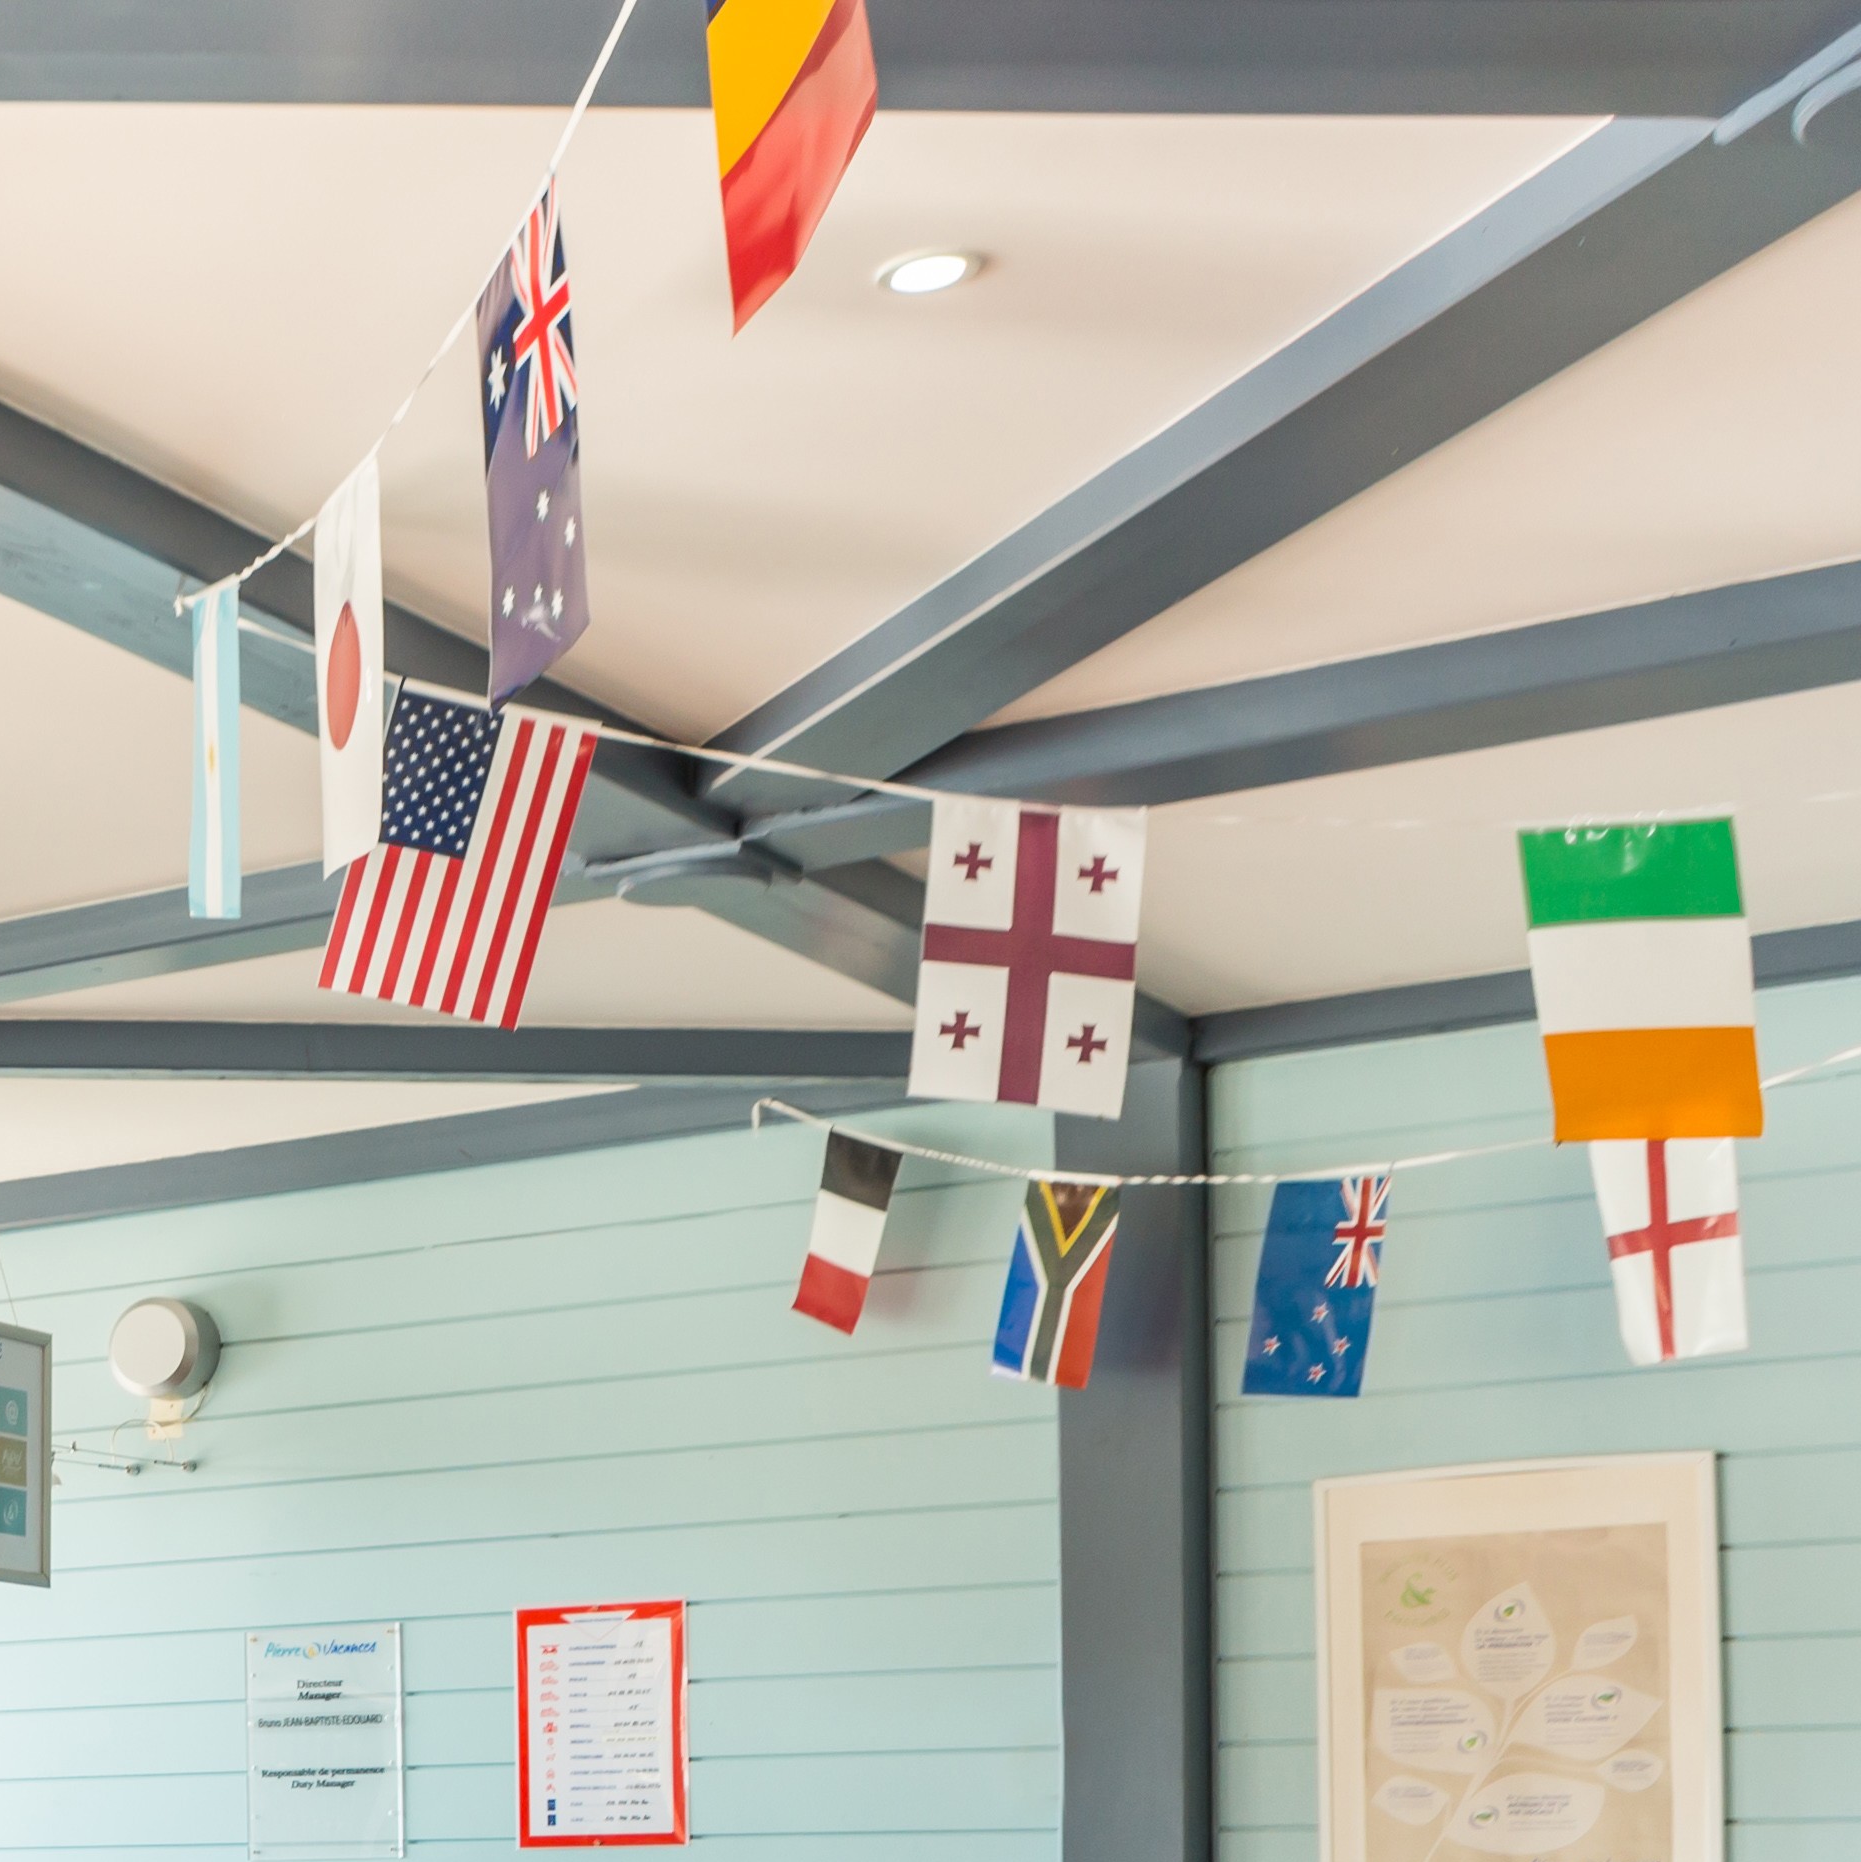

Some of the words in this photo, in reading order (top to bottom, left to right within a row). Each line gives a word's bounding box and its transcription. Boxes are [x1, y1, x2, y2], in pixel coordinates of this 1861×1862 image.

[264, 1641, 302, 1659] Pierre
[323, 1639, 377, 1655] Vacances
[296, 1679, 343, 1689] Directeur
[297, 1691, 342, 1701] Manager
[261, 1768, 316, 1779] Responsable
[318, 1768, 328, 1776] de
[331, 1767, 385, 1778] permanence
[291, 1780, 313, 1790] Duty
[316, 1779, 356, 1789] Manager
